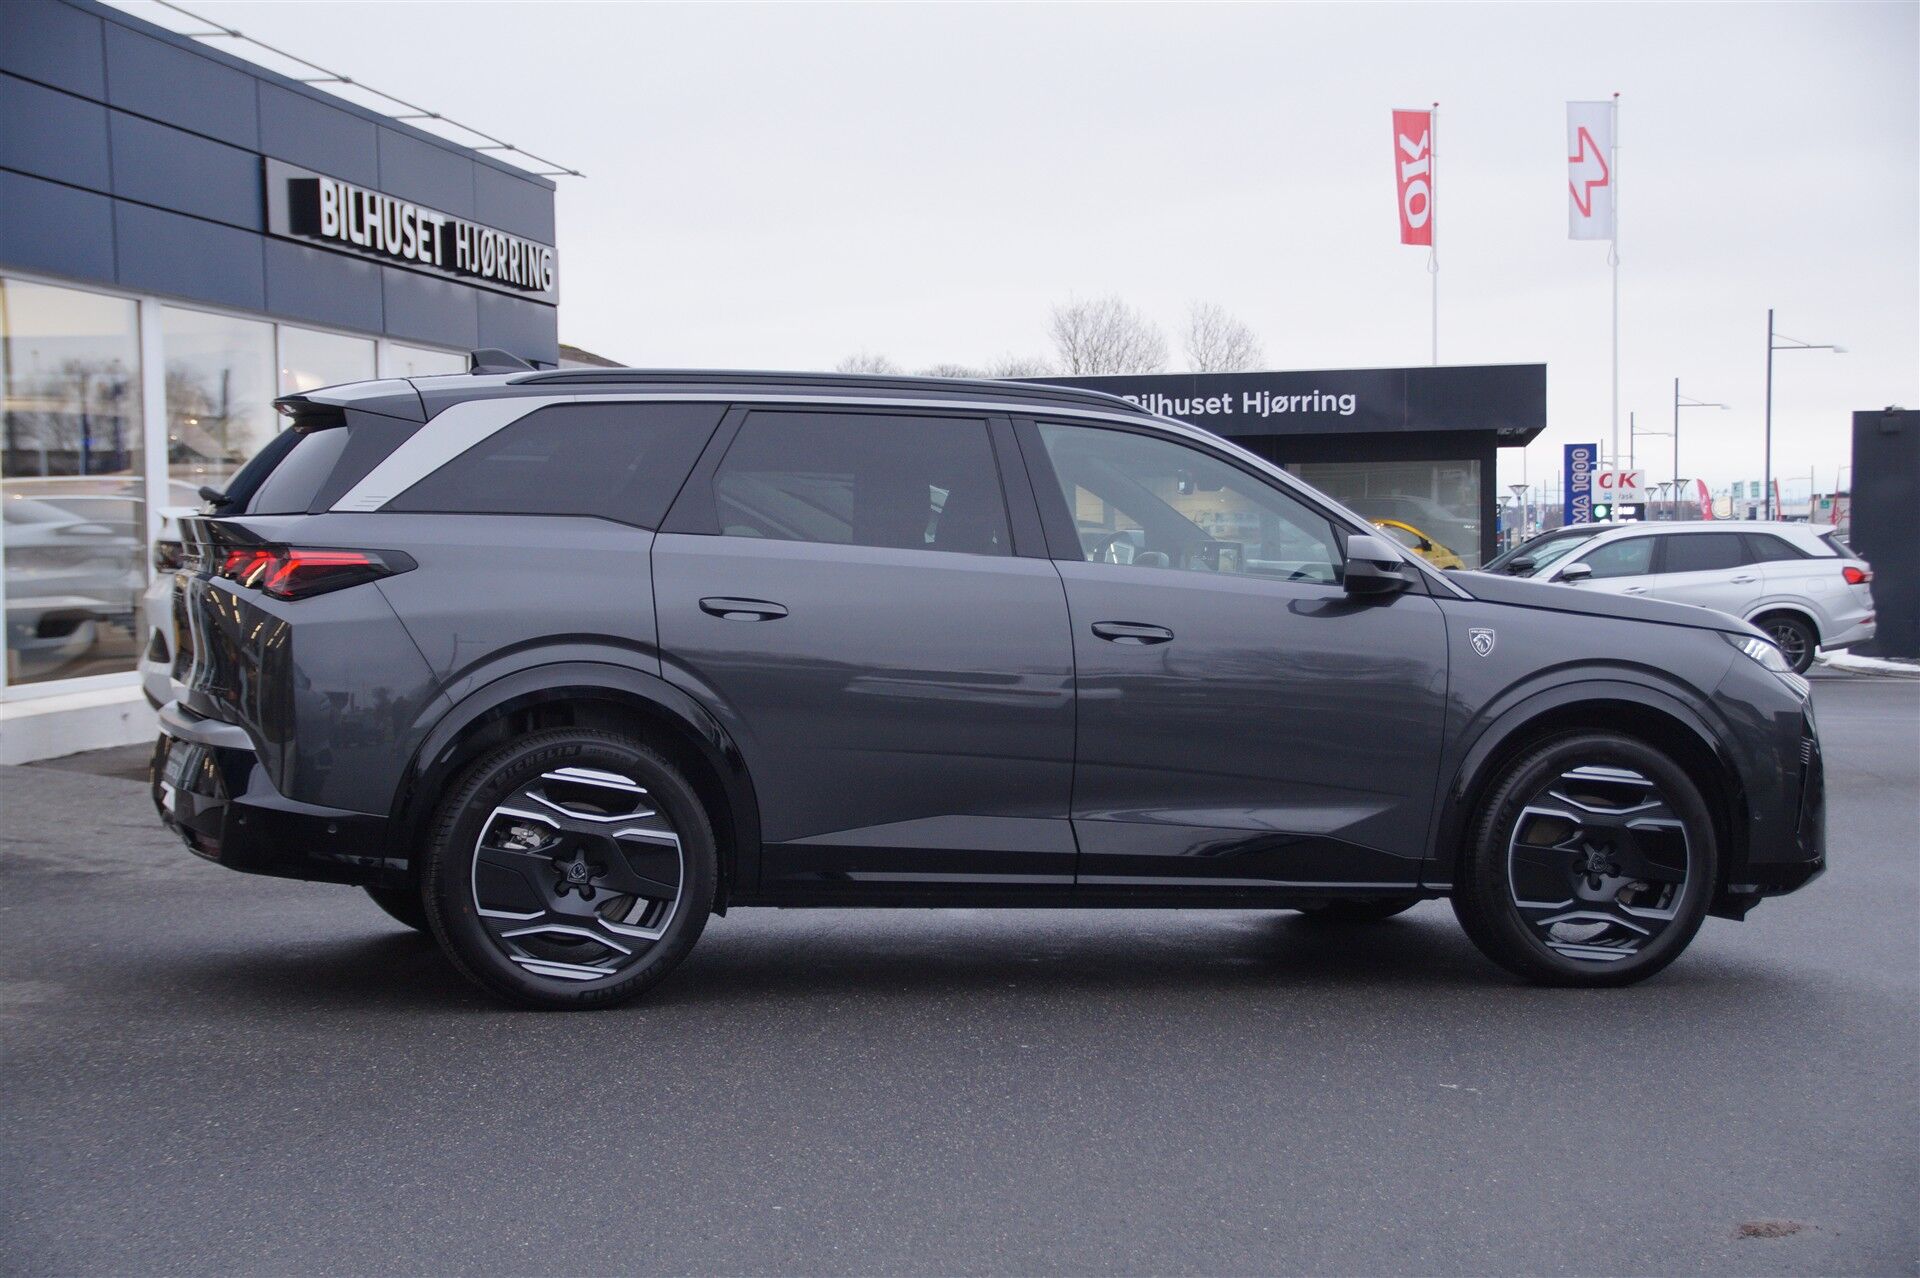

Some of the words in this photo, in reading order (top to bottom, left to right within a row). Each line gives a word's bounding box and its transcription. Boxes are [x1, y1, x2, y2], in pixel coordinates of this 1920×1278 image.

[1399, 129, 1430, 228] OK
[319, 177, 446, 266] BILHUSET
[455, 220, 552, 293] HJØRRING
[1243, 390, 1356, 417] Hjørring
[1571, 448, 1590, 492] 1000
[1598, 472, 1638, 489] OK
